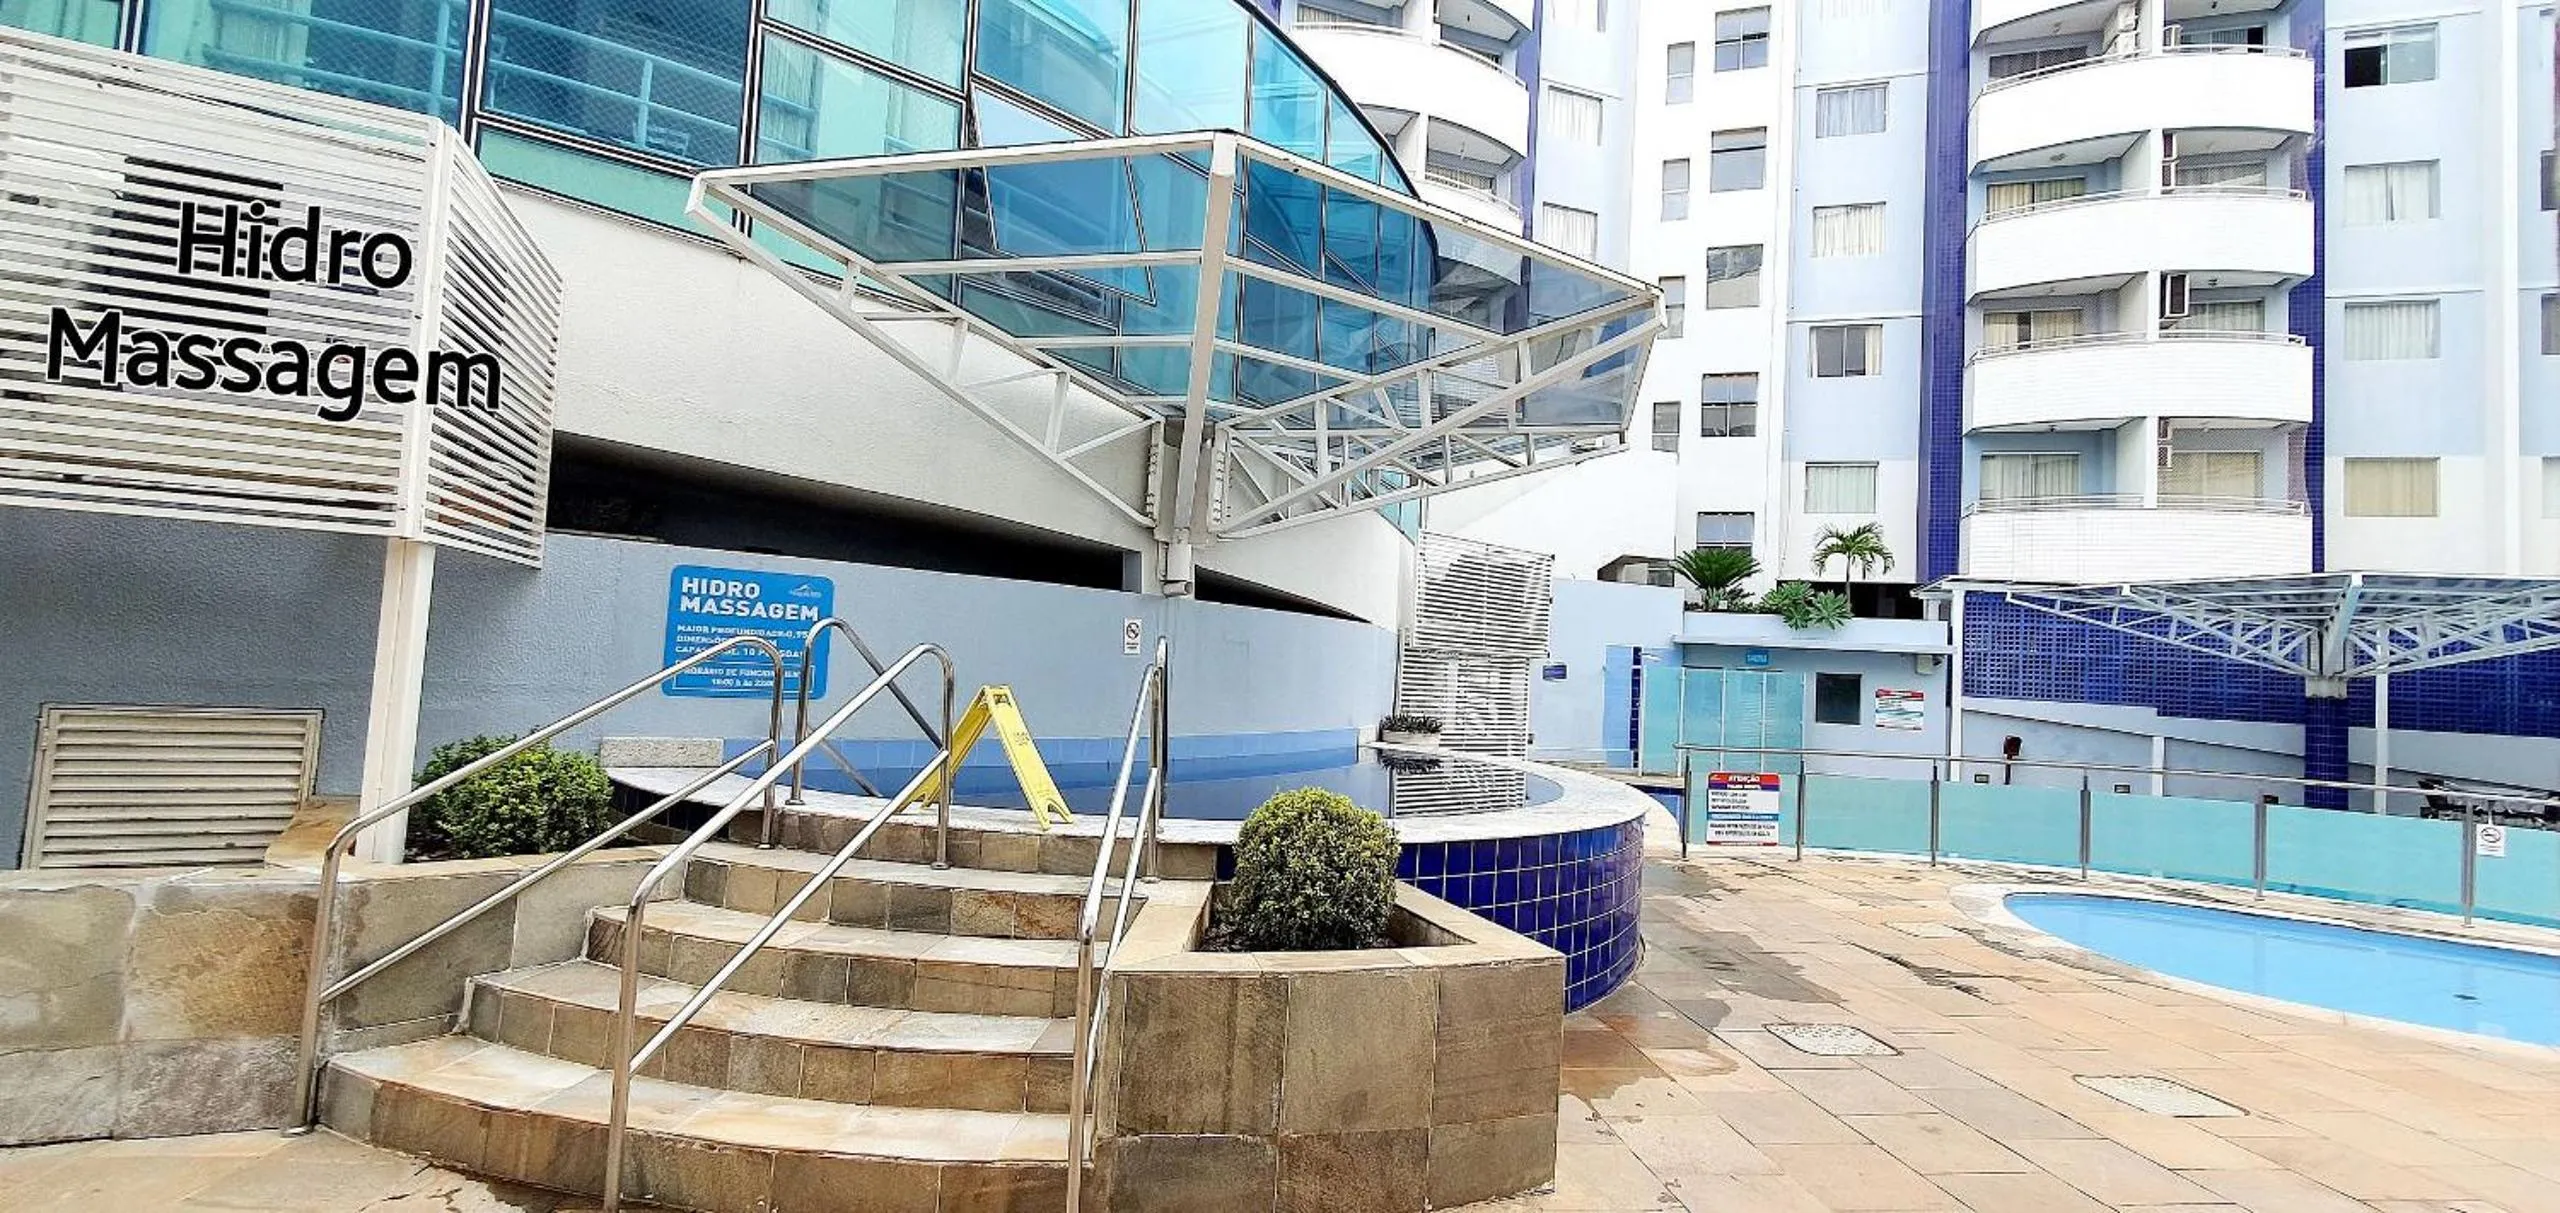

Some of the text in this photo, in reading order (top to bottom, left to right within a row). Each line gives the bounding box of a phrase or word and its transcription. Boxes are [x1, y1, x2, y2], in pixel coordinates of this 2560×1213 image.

[681, 576, 761, 599] HIDRO
[680, 595, 819, 621] MASSAGEM
[677, 624, 709, 634] MAIOR
